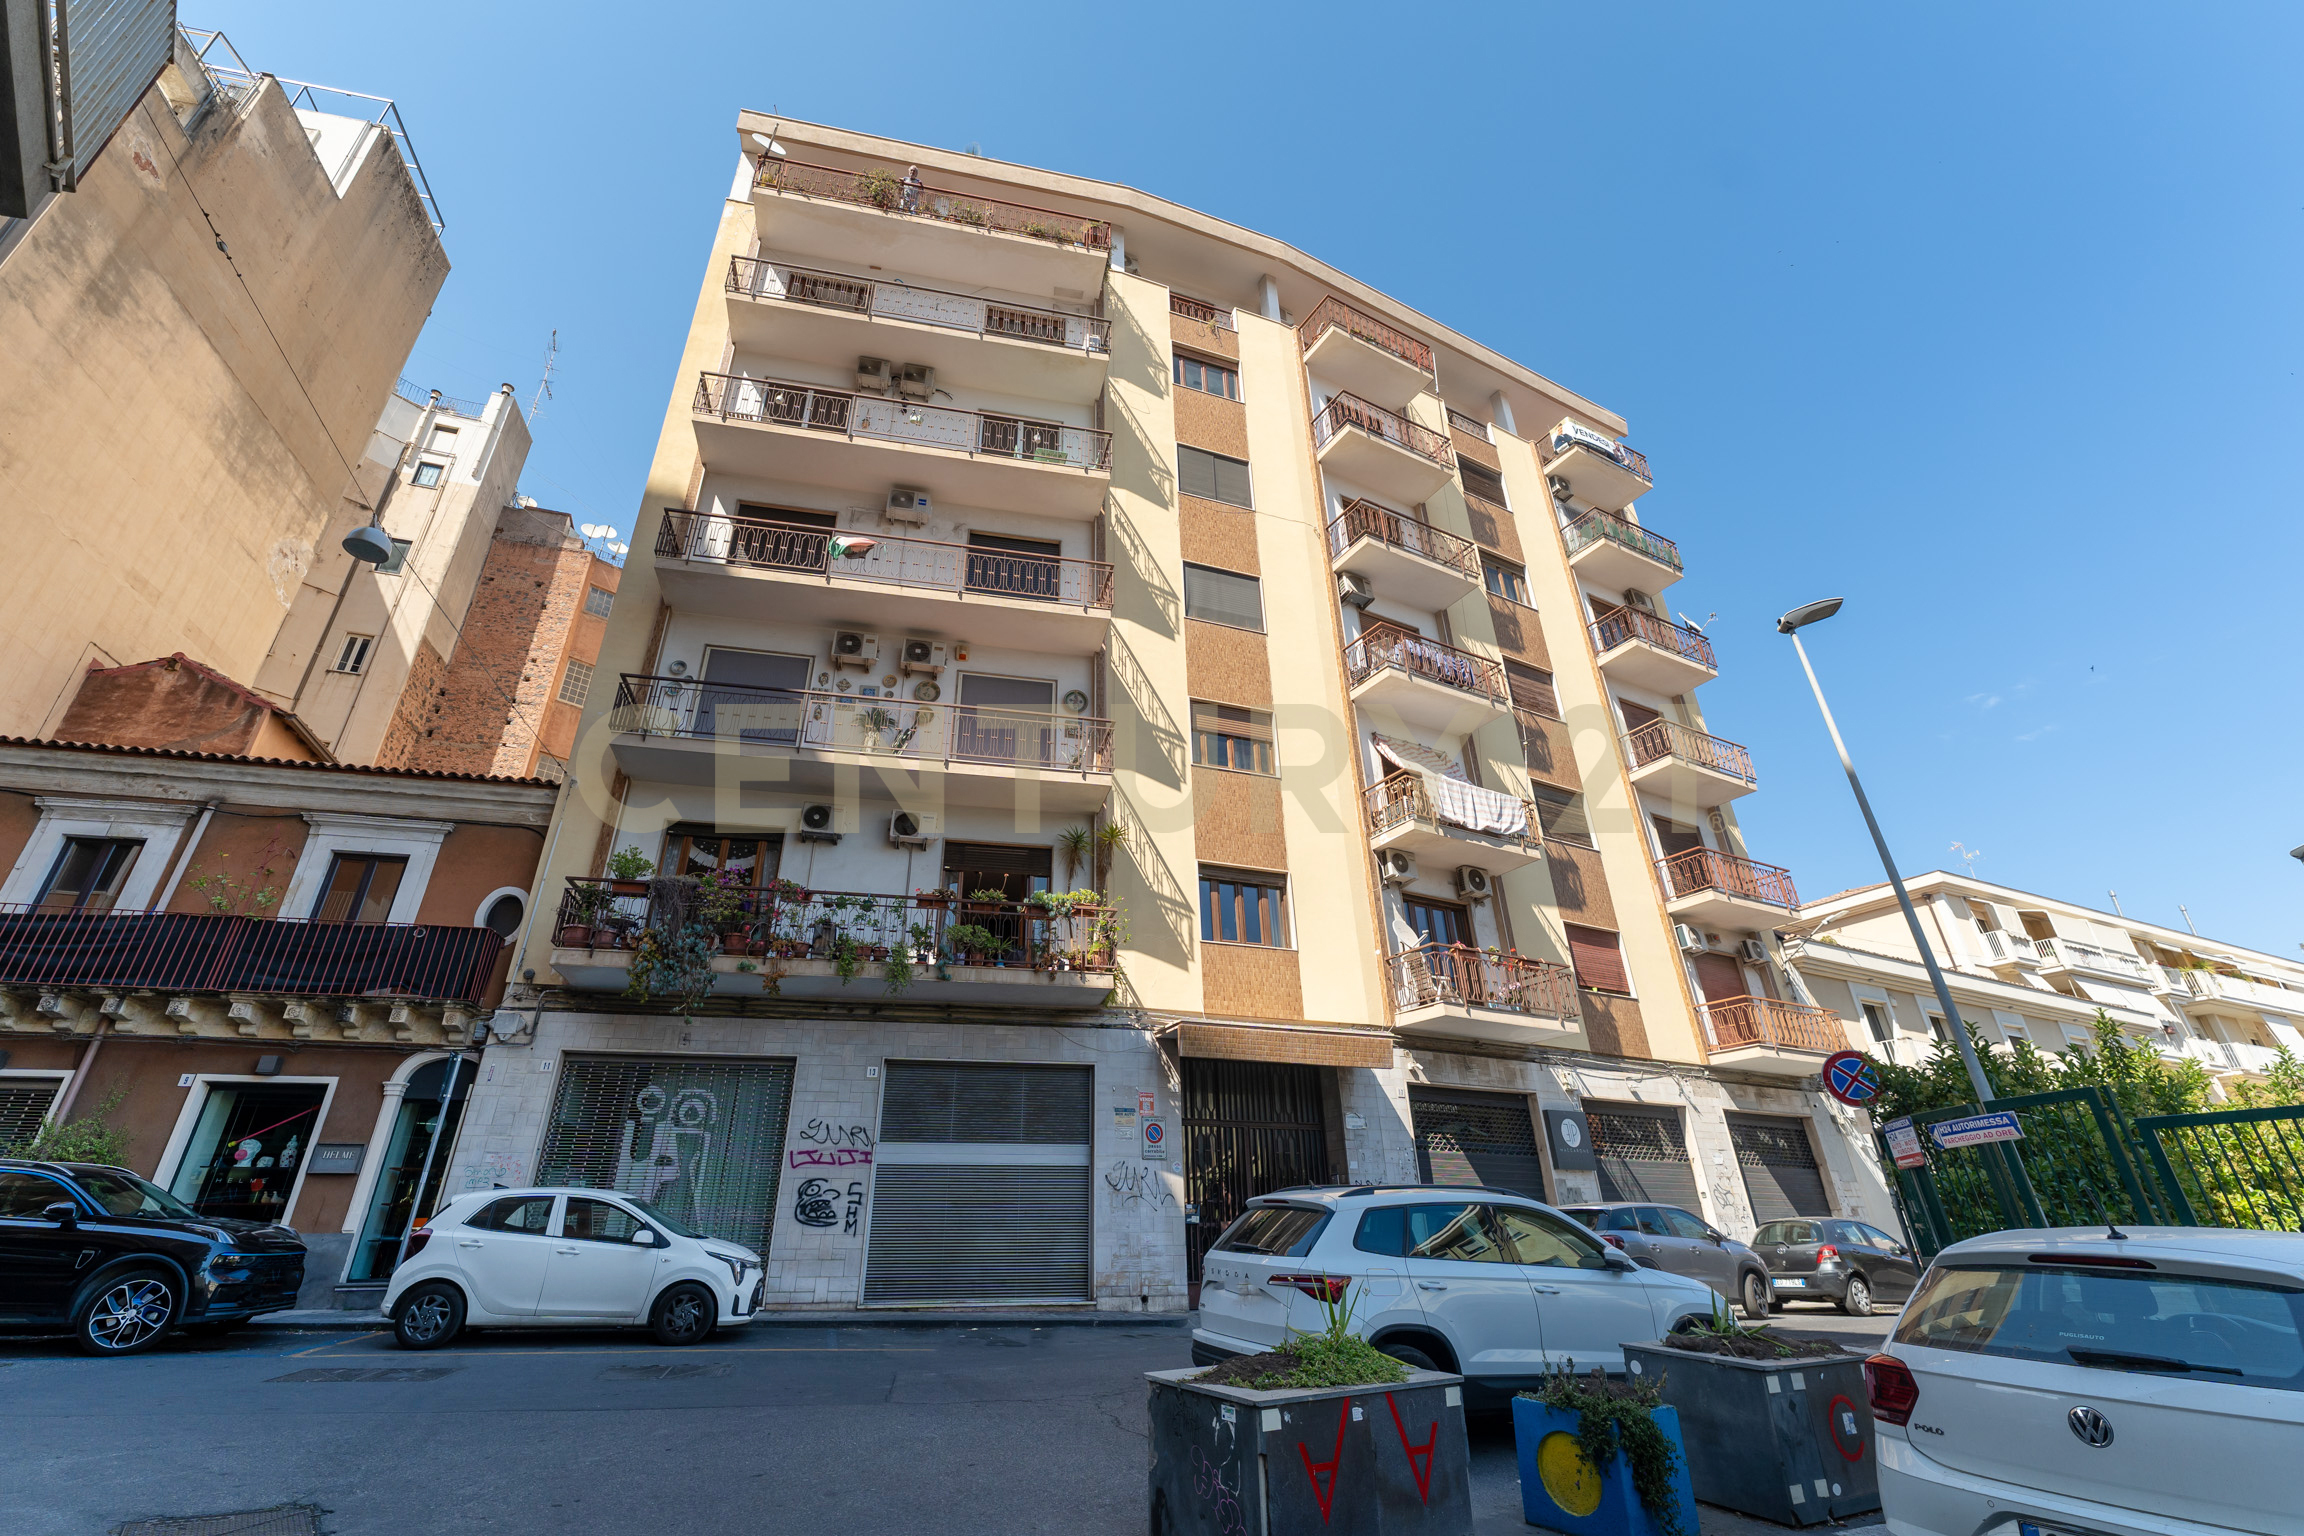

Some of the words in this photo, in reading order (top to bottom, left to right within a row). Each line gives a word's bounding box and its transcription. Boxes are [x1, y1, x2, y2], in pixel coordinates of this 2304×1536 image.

[1939, 1125, 1952, 1135] H24
[1952, 1116, 2011, 1132] AUTORIMESSA
[1944, 1134, 1982, 1145] PARCHEGGIO
[1983, 1131, 1994, 1139] AD
[1995, 1128, 2015, 1138] ORE
[2059, 1331, 2105, 1341] PUGLISAUTO
[1914, 1422, 1945, 1436] POLO
